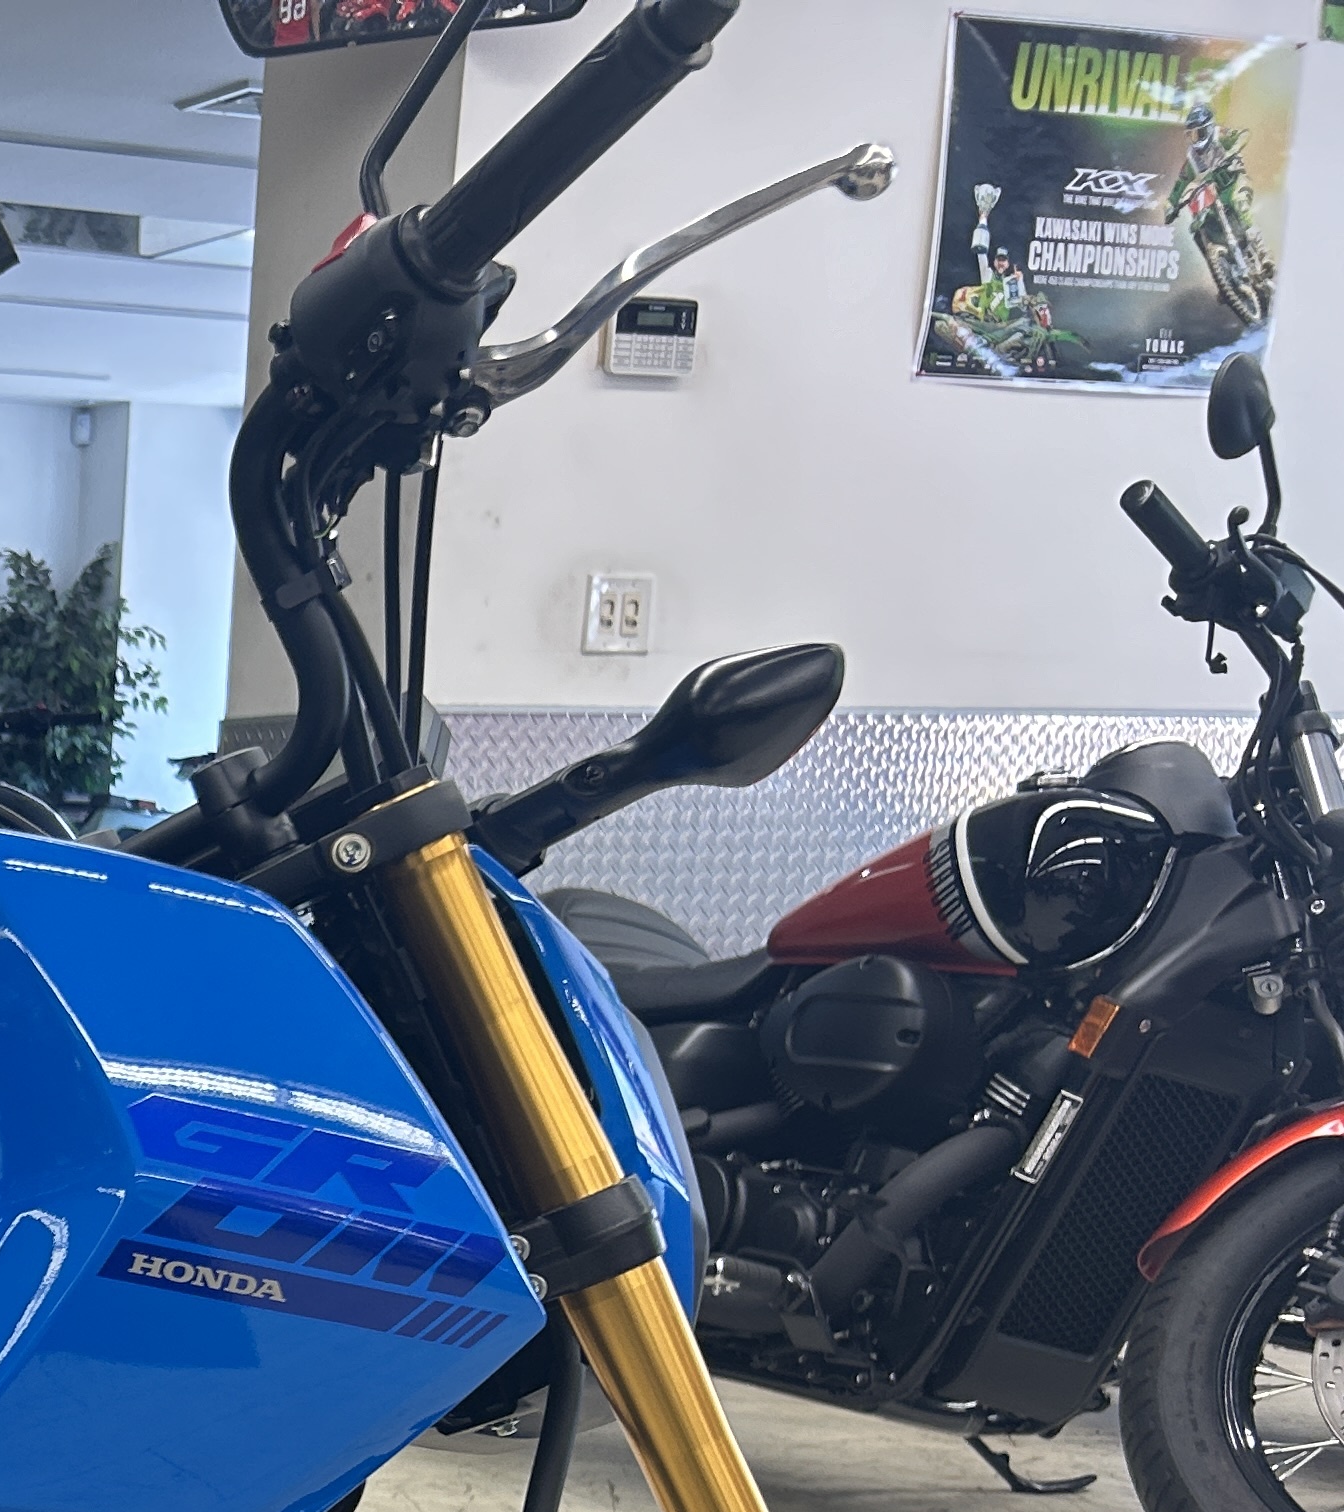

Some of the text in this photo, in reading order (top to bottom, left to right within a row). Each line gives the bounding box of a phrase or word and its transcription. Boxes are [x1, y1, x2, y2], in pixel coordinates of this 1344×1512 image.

[1035, 216, 1102, 242] KAWASAKI
[1103, 222, 1137, 245] WINS
[1028, 240, 1180, 280] CHAMPIONSHIPS
[1145, 338, 1184, 354] TOMAC
[128, 1252, 286, 1303] HONDA
